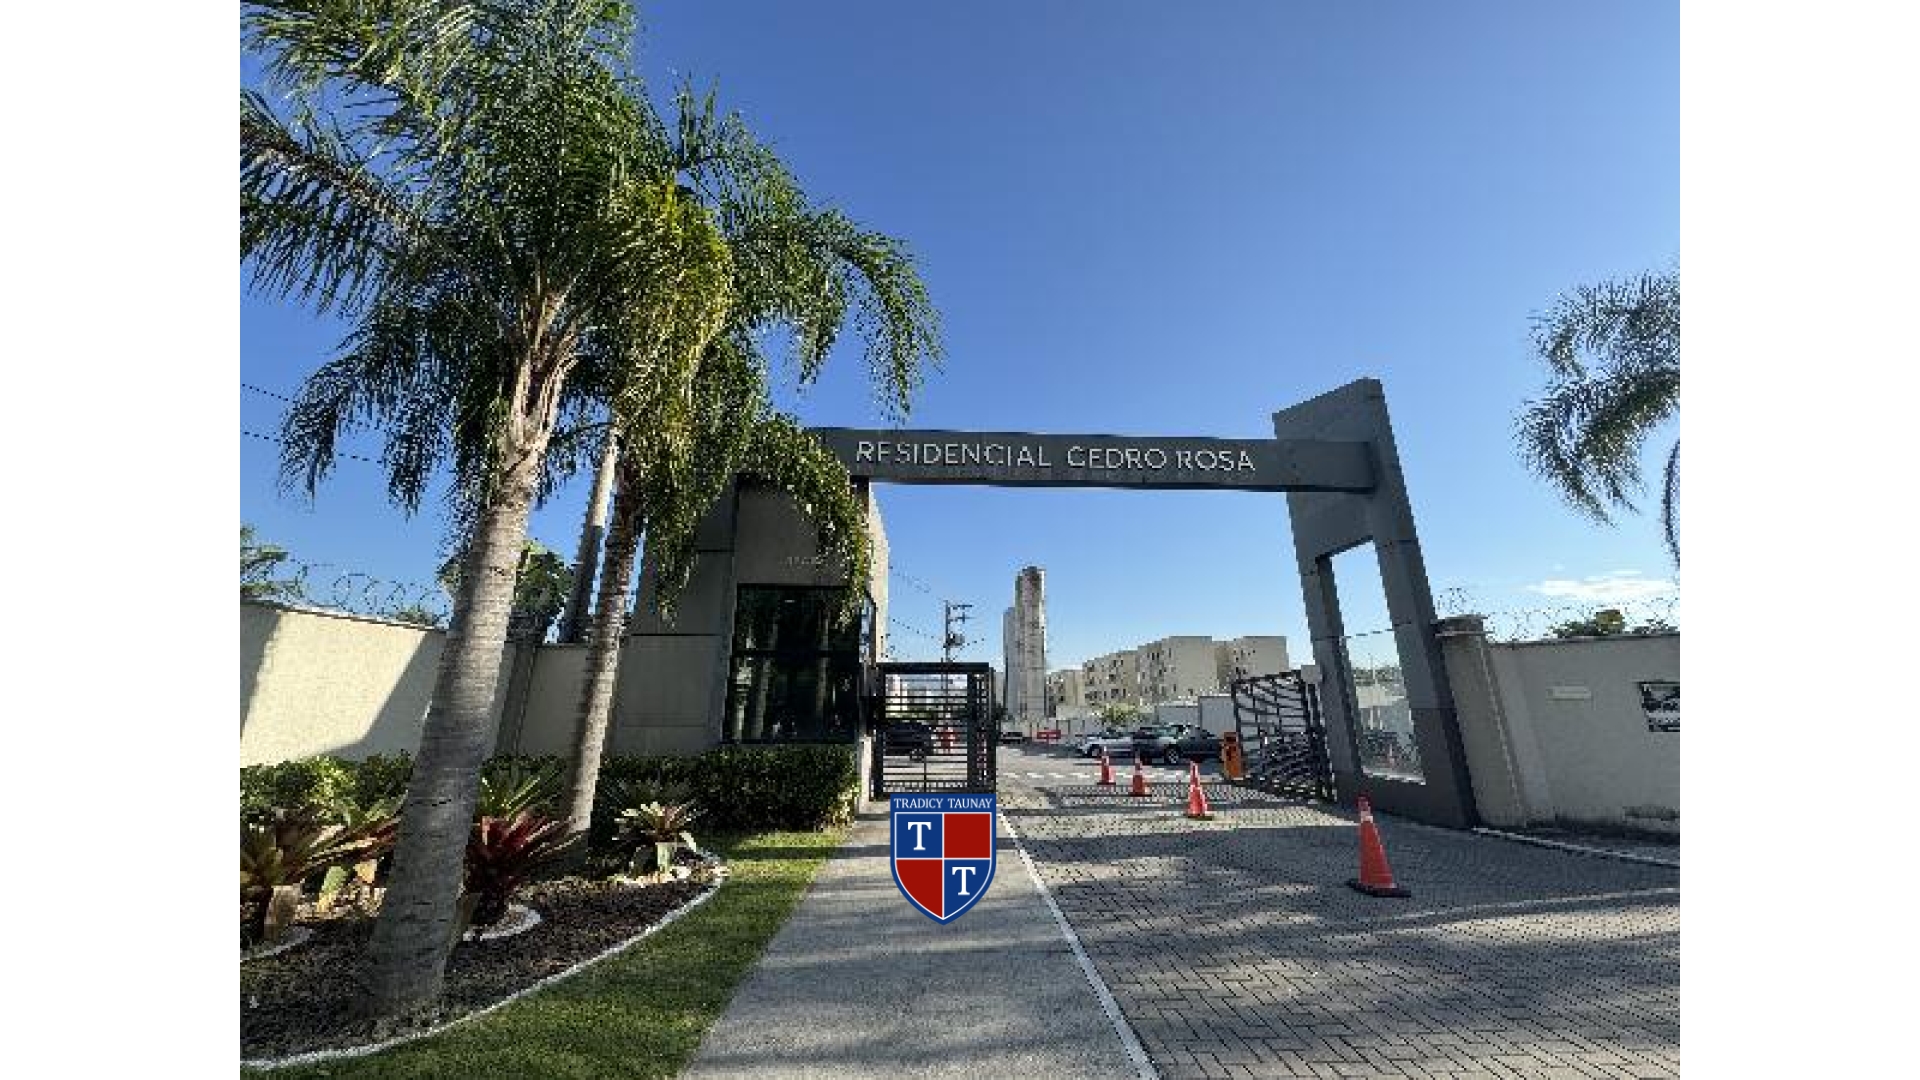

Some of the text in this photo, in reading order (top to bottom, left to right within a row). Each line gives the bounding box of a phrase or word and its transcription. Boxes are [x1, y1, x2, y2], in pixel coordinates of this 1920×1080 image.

[856, 441, 1256, 472] RESIDENCIAL CEDRO ROSA
